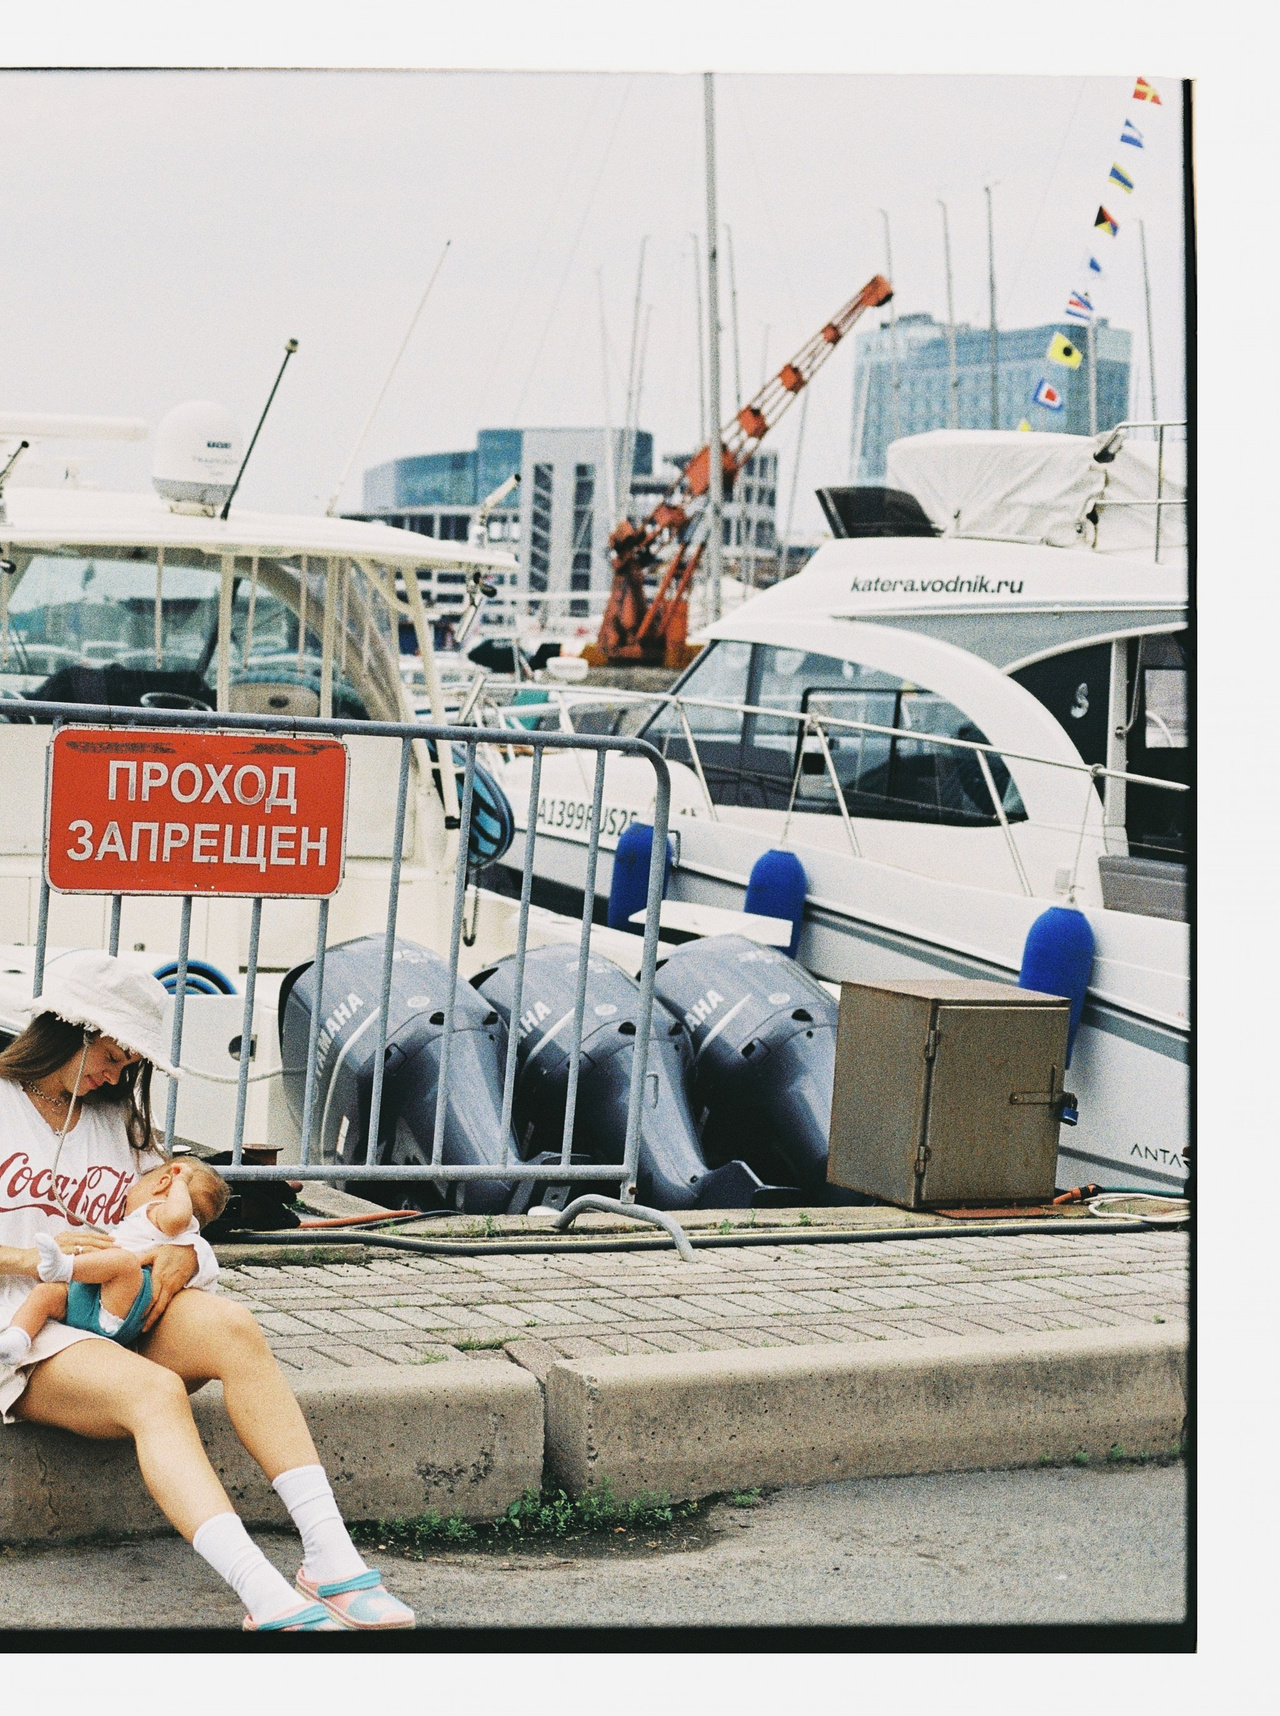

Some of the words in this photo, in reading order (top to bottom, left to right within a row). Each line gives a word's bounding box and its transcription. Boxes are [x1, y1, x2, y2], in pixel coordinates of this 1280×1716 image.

[850, 575, 1024, 594] katera.vodnik.ru
[108, 760, 297, 814] ПРОХОД
[66, 819, 328, 872] ЗАПРЕЩЕН
